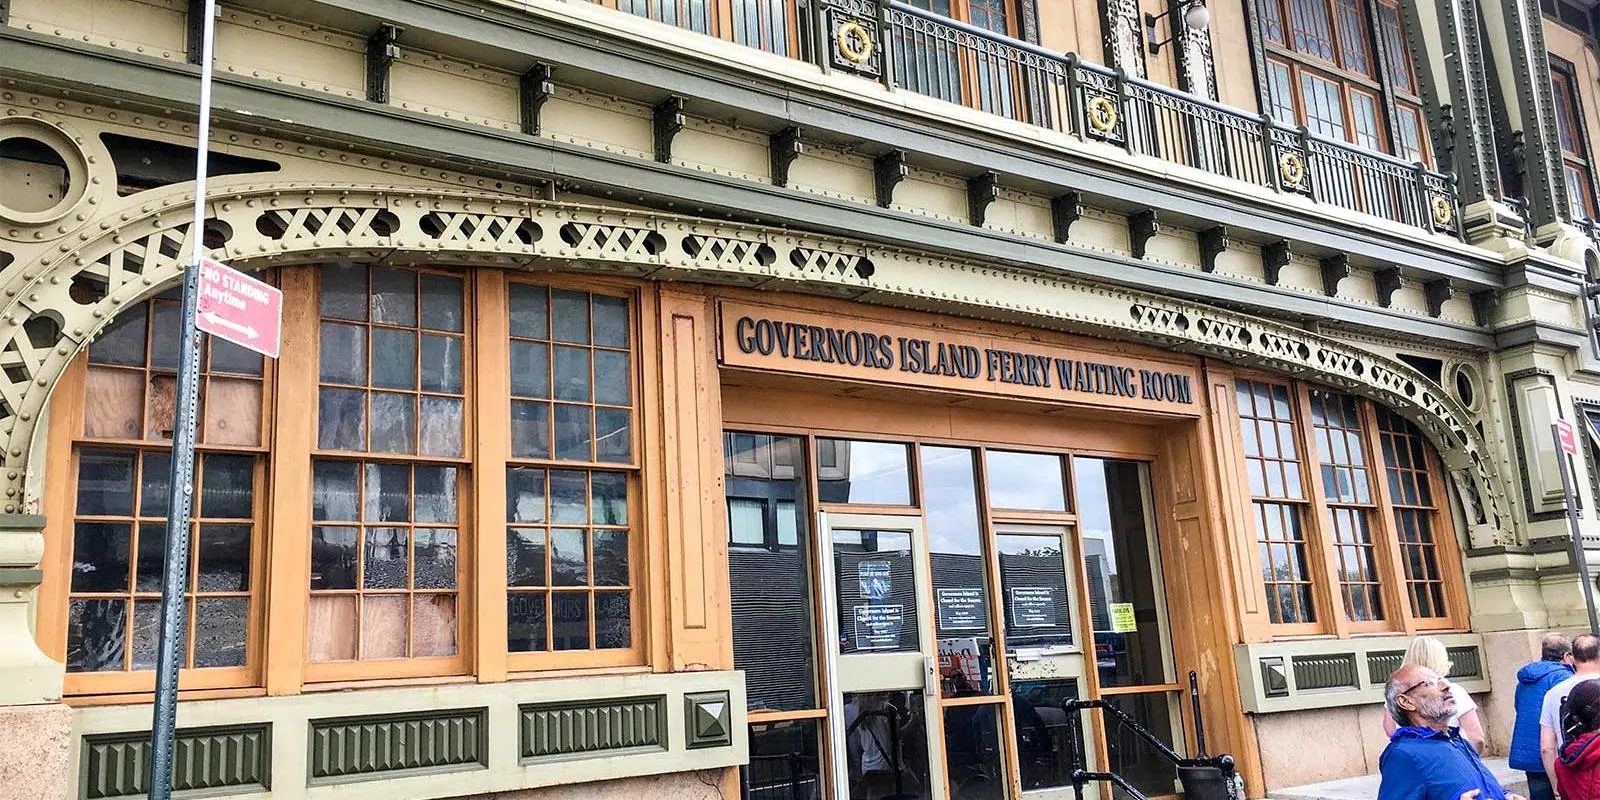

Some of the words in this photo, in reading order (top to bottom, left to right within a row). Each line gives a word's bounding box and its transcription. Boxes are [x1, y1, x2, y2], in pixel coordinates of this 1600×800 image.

[203, 266, 220, 283] NO
[221, 274, 270, 305] STANDING
[203, 283, 247, 311] Anytime
[737, 316, 894, 370] GOVERNORS
[898, 337, 982, 379] ISLAND
[985, 348, 1052, 387] FERRY
[1055, 357, 1138, 398] WAITING
[1139, 369, 1193, 404] ROOM
